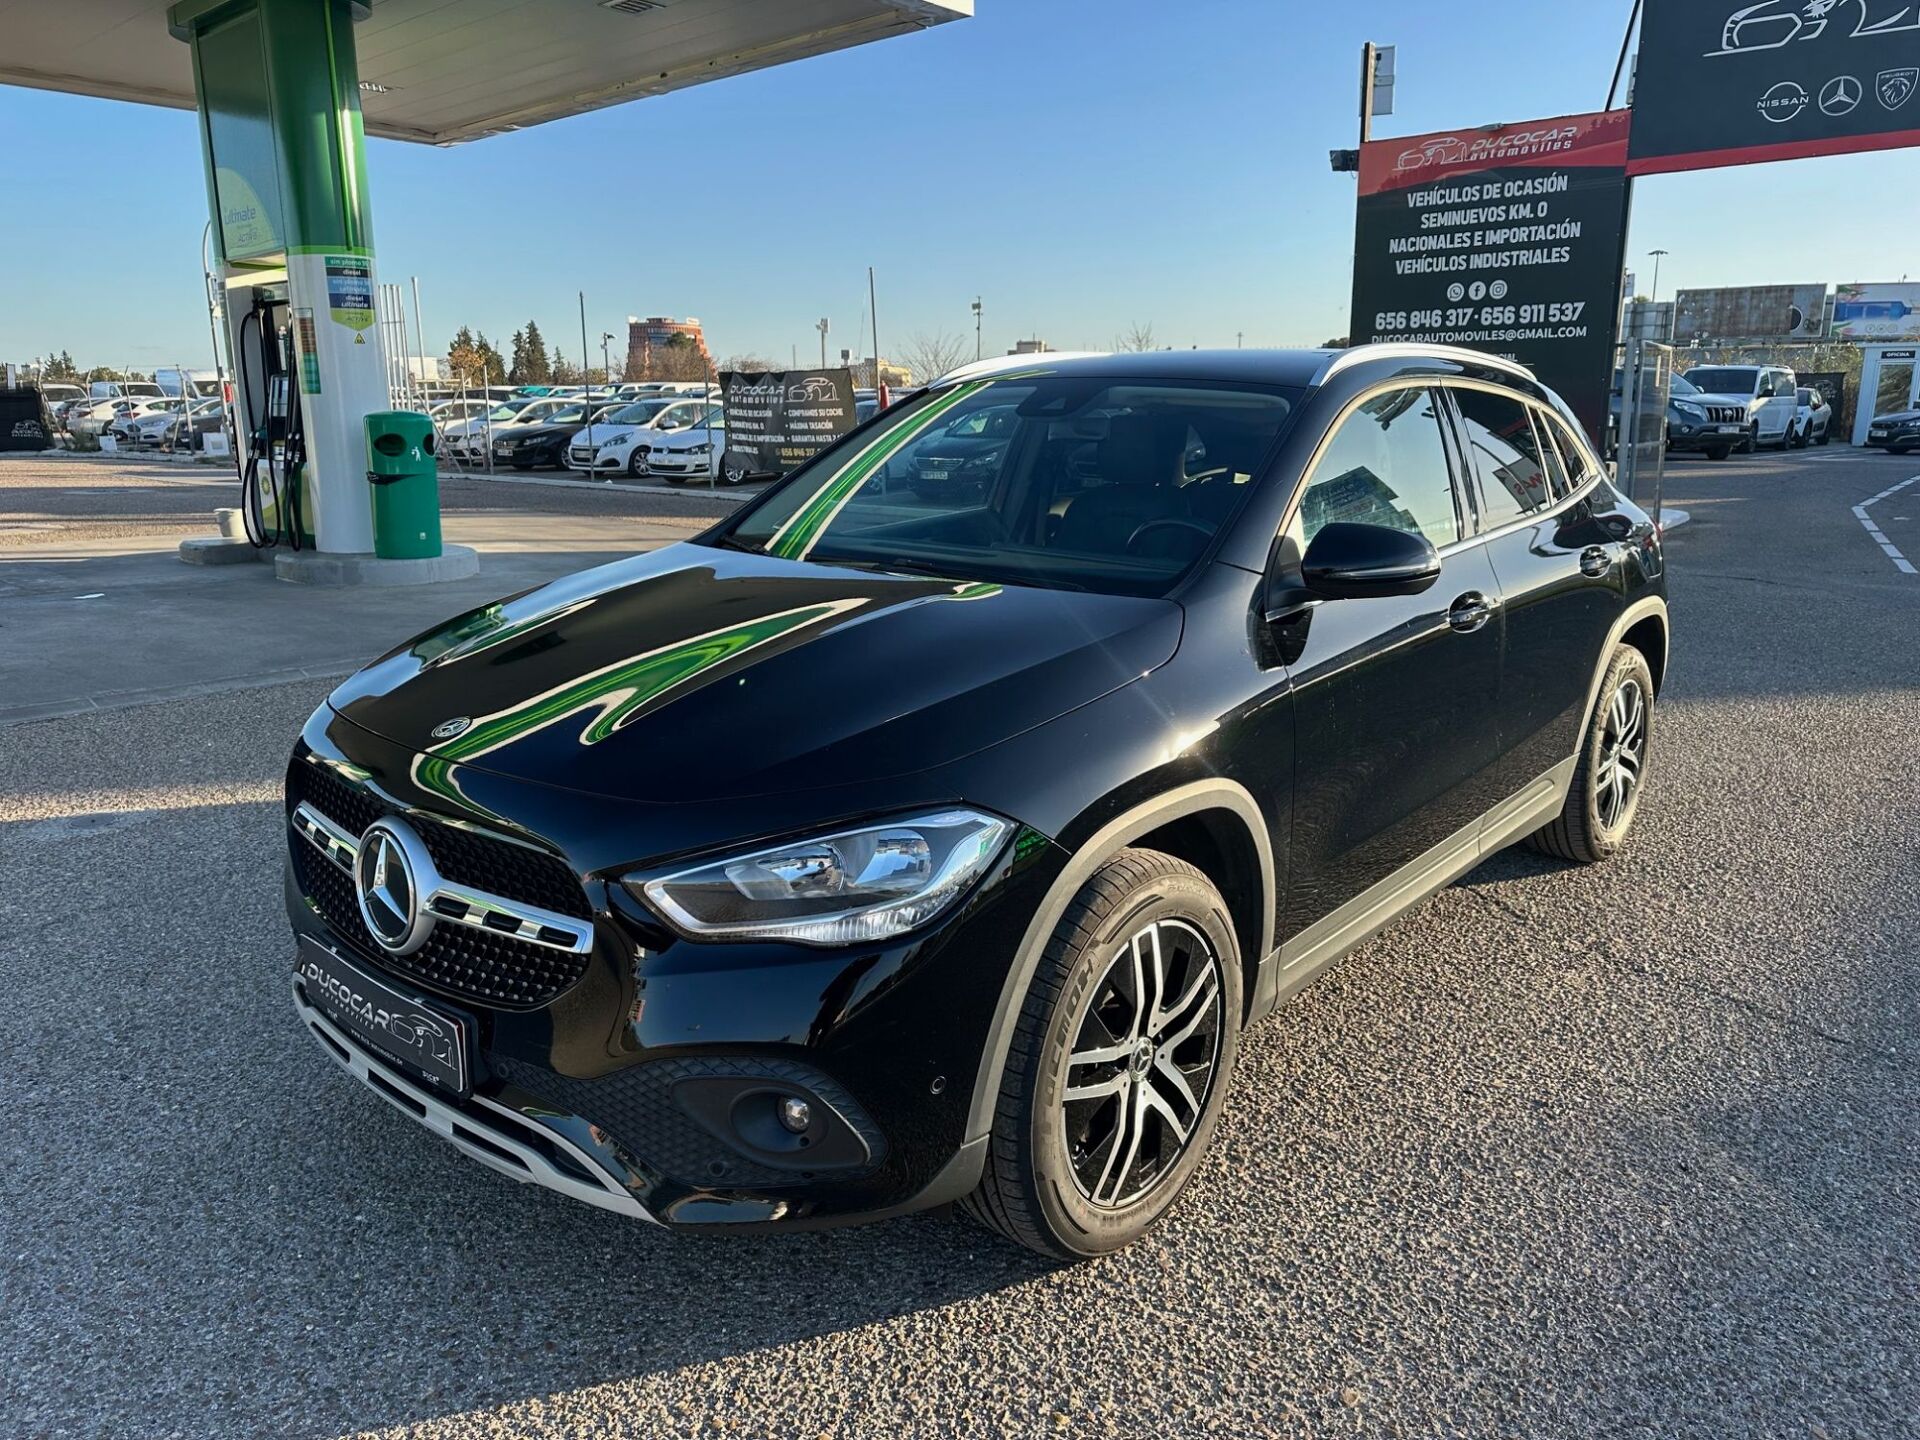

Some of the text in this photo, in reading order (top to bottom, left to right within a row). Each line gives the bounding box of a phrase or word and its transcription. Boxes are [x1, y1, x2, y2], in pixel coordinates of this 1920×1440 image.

[1757, 96, 1809, 109] NISSAN
[1470, 126, 1577, 151] DUCOCAR
[1470, 140, 1573, 161] automoviles
[1407, 172, 1569, 208] VEHÍCULOS DE OCASIÓN
[1420, 205, 1507, 229] SEMINUEVOS
[1508, 202, 1534, 220] KM.
[1388, 218, 1582, 254] NACIONALES E IMPORTACIÓN
[1395, 246, 1571, 275] VEHÍCULOS INDUSTRIALES
[1375, 311, 1407, 330] 656
[1409, 309, 1442, 328] 846
[1519, 304, 1546, 323] 911
[1548, 301, 1586, 322] 537
[730, 385, 785, 395] DUCOCAR
[306, 962, 390, 1030] DUCOCAR
